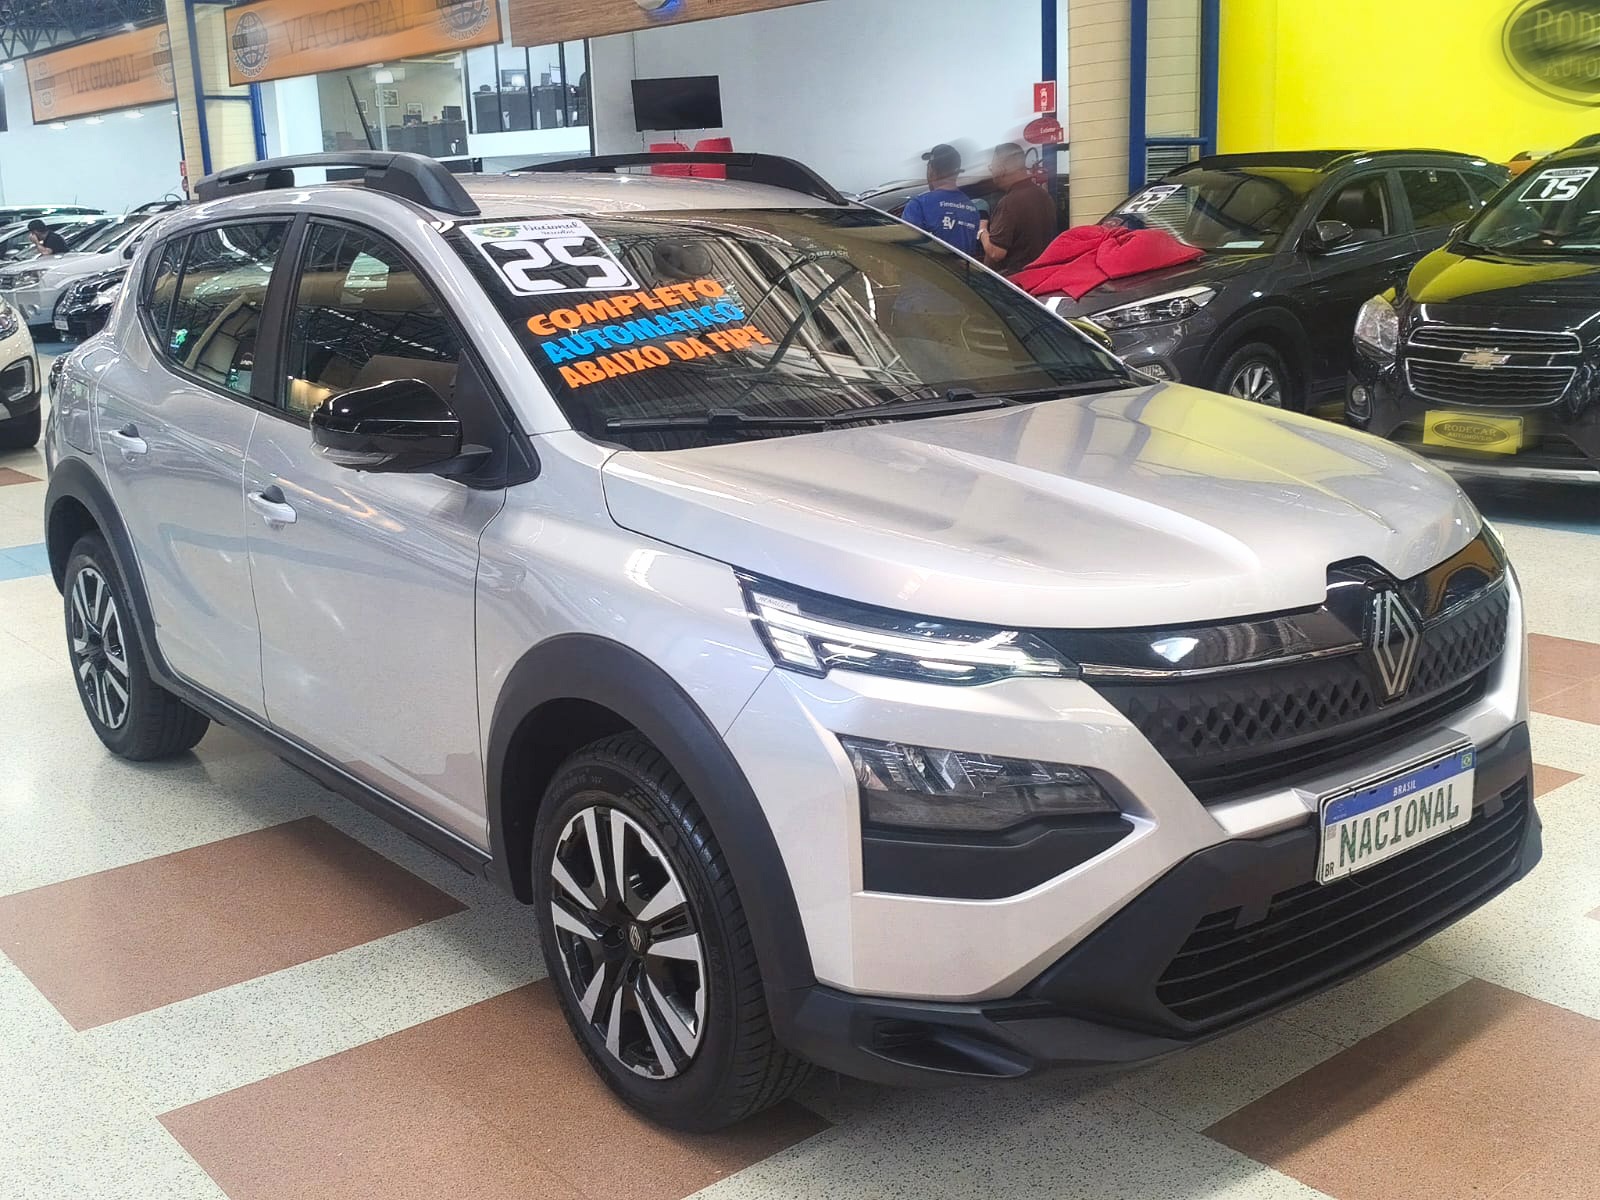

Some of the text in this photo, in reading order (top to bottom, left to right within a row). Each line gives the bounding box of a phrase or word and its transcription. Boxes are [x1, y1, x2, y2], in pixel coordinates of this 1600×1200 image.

[283, 15, 319, 53] VIA
[324, 0, 415, 46] GLOBAL
[65, 65, 89, 95] VIA
[90, 54, 139, 90] GLOBAL
[1124, 194, 1167, 213] 22
[1540, 178, 1583, 199] 15
[490, 237, 628, 291] 25
[527, 278, 725, 336] COMPLETO
[541, 301, 745, 365] AUTOMATICO
[558, 325, 773, 389] ABAIXO DA FIPE
[1444, 423, 1497, 436] RODECAR
[1393, 780, 1416, 796] BRASIL
[1340, 784, 1459, 868] NACIONAL
[1325, 862, 1334, 877] BR
